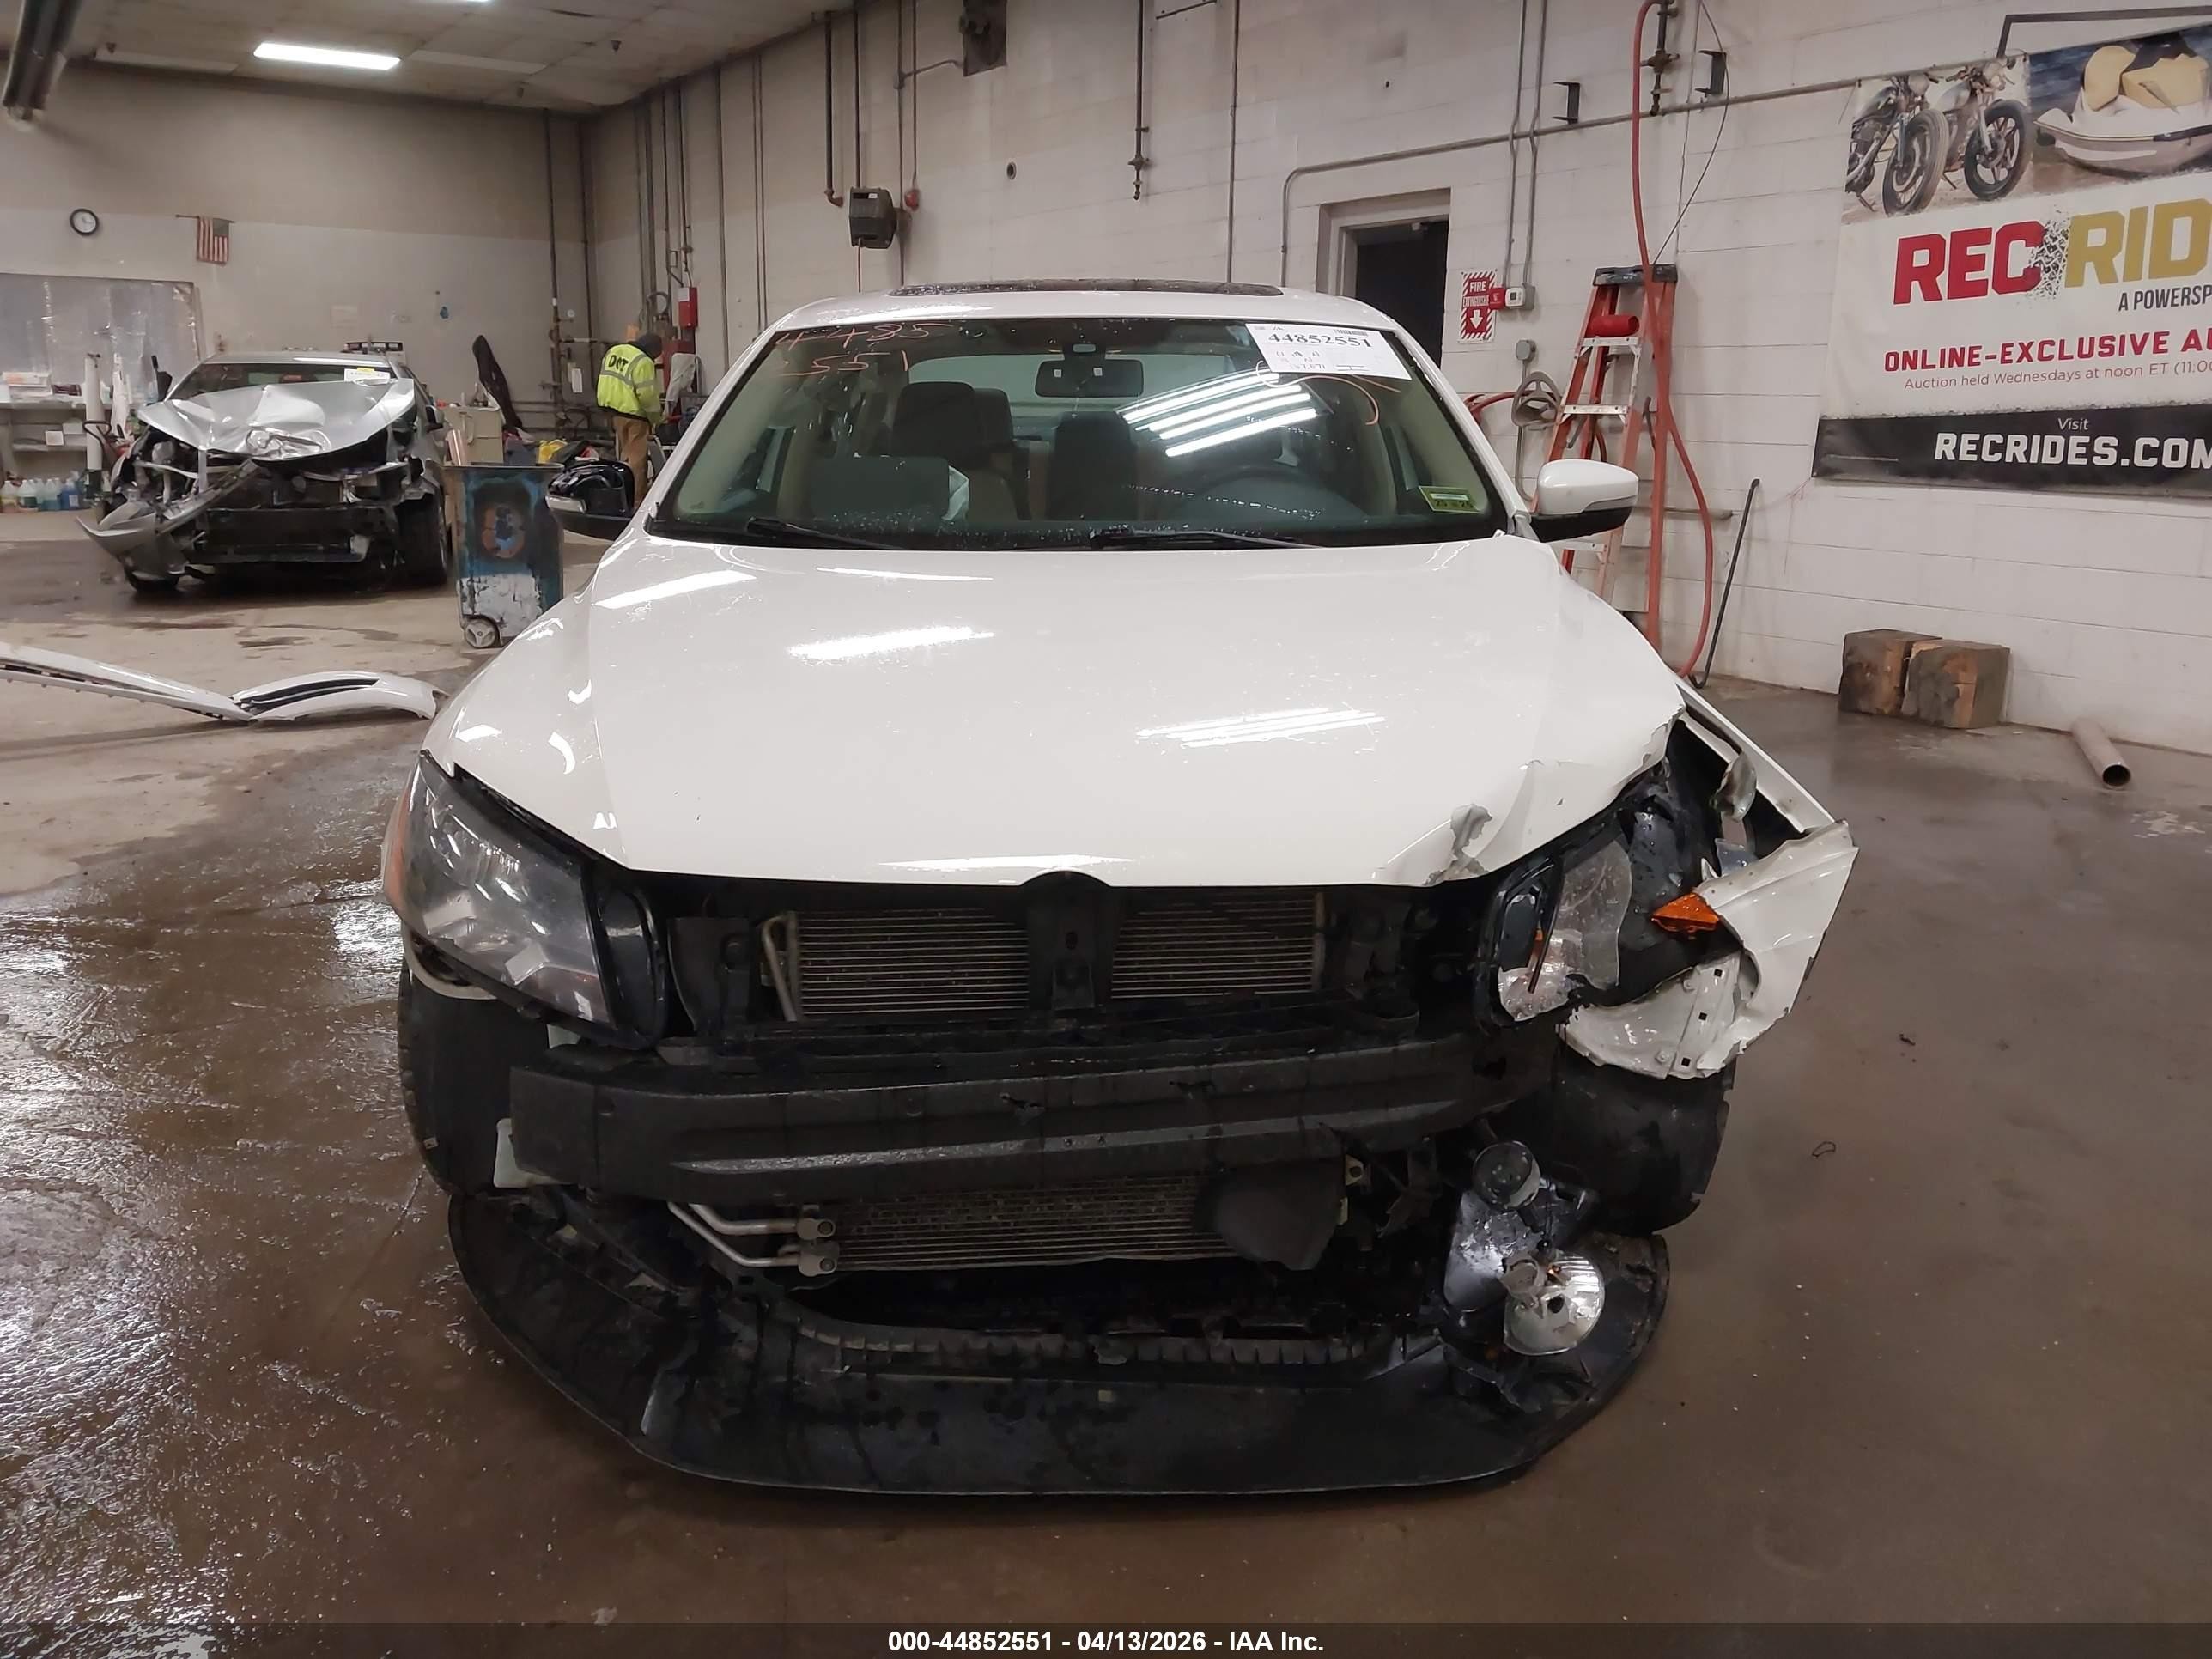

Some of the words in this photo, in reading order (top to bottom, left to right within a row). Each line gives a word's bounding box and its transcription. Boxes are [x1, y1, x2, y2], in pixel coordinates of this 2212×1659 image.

[1469, 281, 1487, 293] FIRE
[2118, 292, 2129, 312] A
[1268, 332, 1373, 348] 44852551
[1884, 331, 2170, 372] ONLINE-EXCLUSIVE
[1904, 377, 1957, 390] Auction
[1961, 374, 1990, 386] held
[1994, 369, 2081, 385] Wednesdays
[2085, 368, 2099, 379] at
[2104, 366, 2143, 378] noon
[2149, 362, 2169, 375] ET
[2057, 417, 2089, 431] Visit
